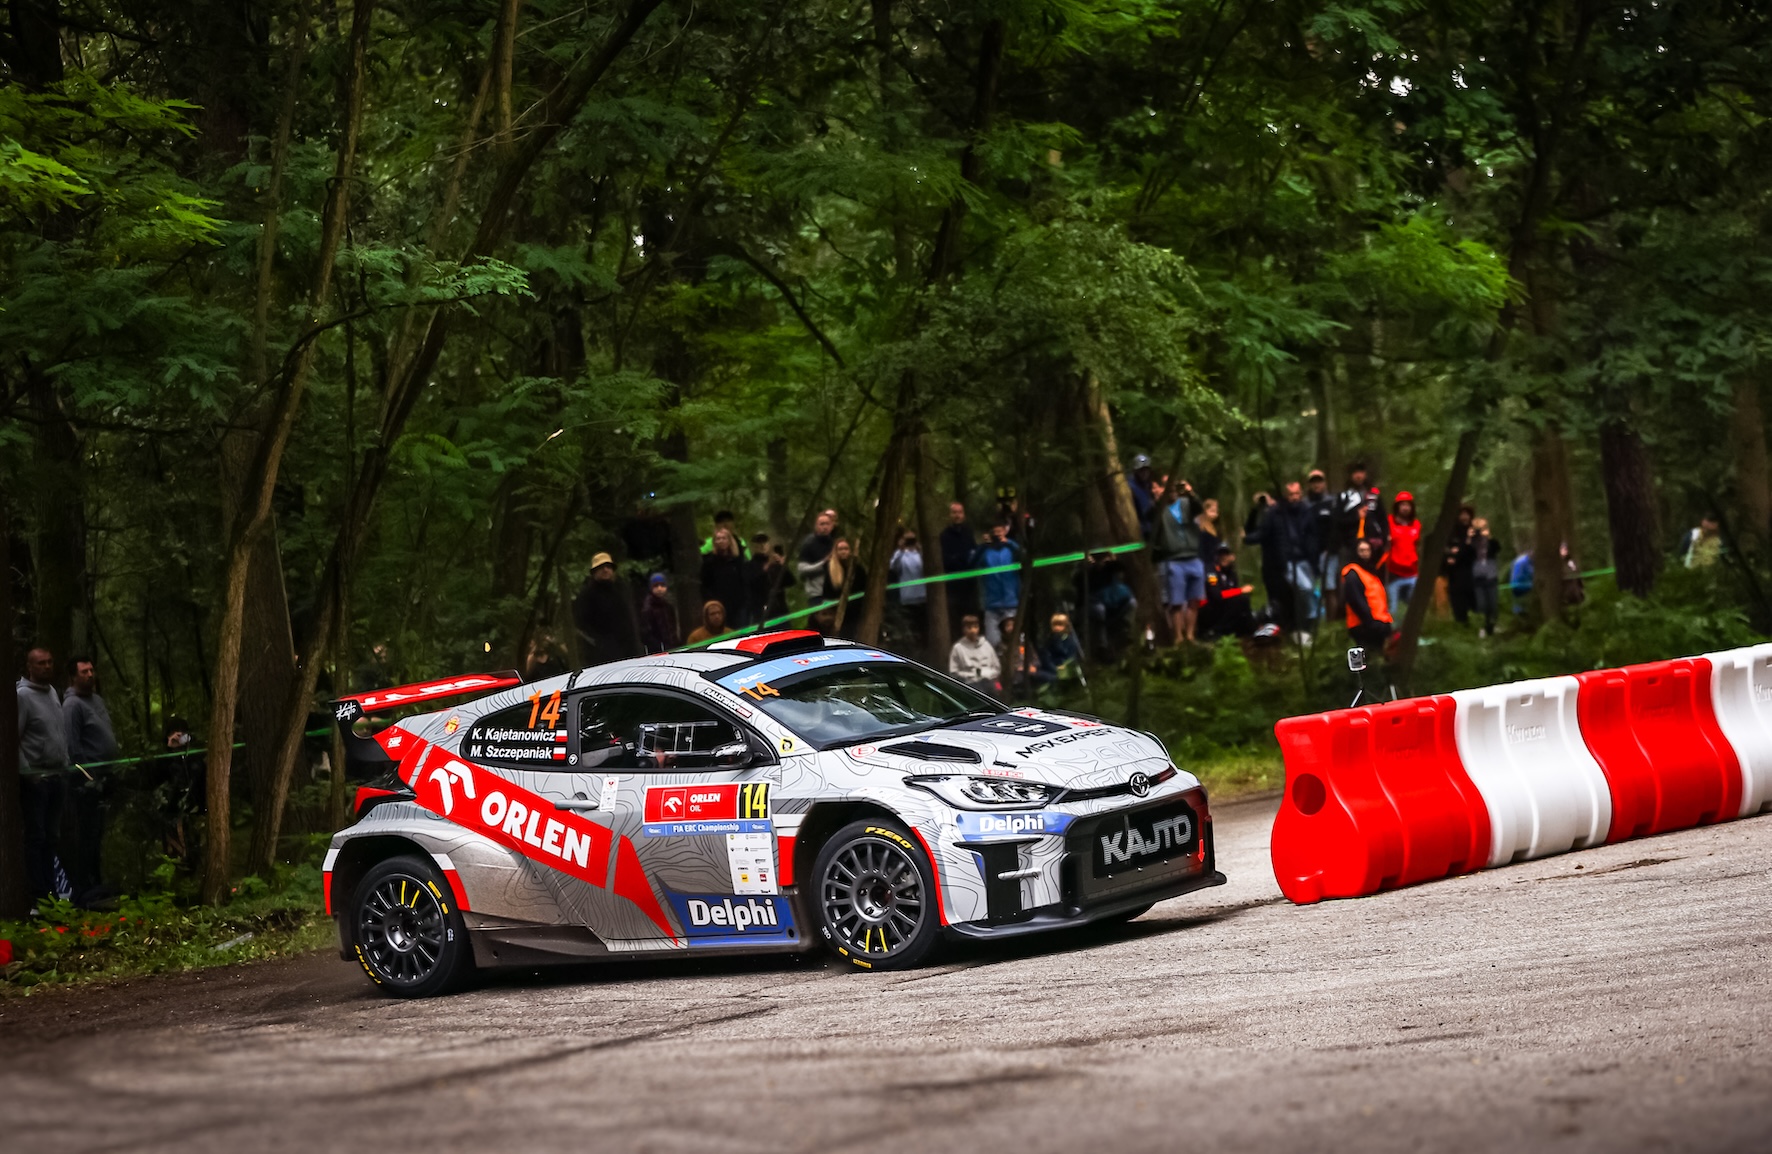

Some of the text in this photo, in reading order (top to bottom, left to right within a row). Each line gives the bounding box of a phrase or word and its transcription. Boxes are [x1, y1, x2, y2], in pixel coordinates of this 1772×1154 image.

[739, 681, 780, 701] 14
[528, 689, 562, 729] 14
[471, 728, 556, 743] K. Kajetanowicz
[470, 744, 552, 760] M. Szczepaniak
[690, 793, 721, 804] ORLEN
[690, 804, 702, 813] OIL
[743, 783, 767, 818] 14
[481, 791, 592, 869] ORLEN
[673, 823, 740, 833] FIA ERC Championship
[980, 814, 1044, 834] Delphi
[688, 899, 778, 932] Delphi
